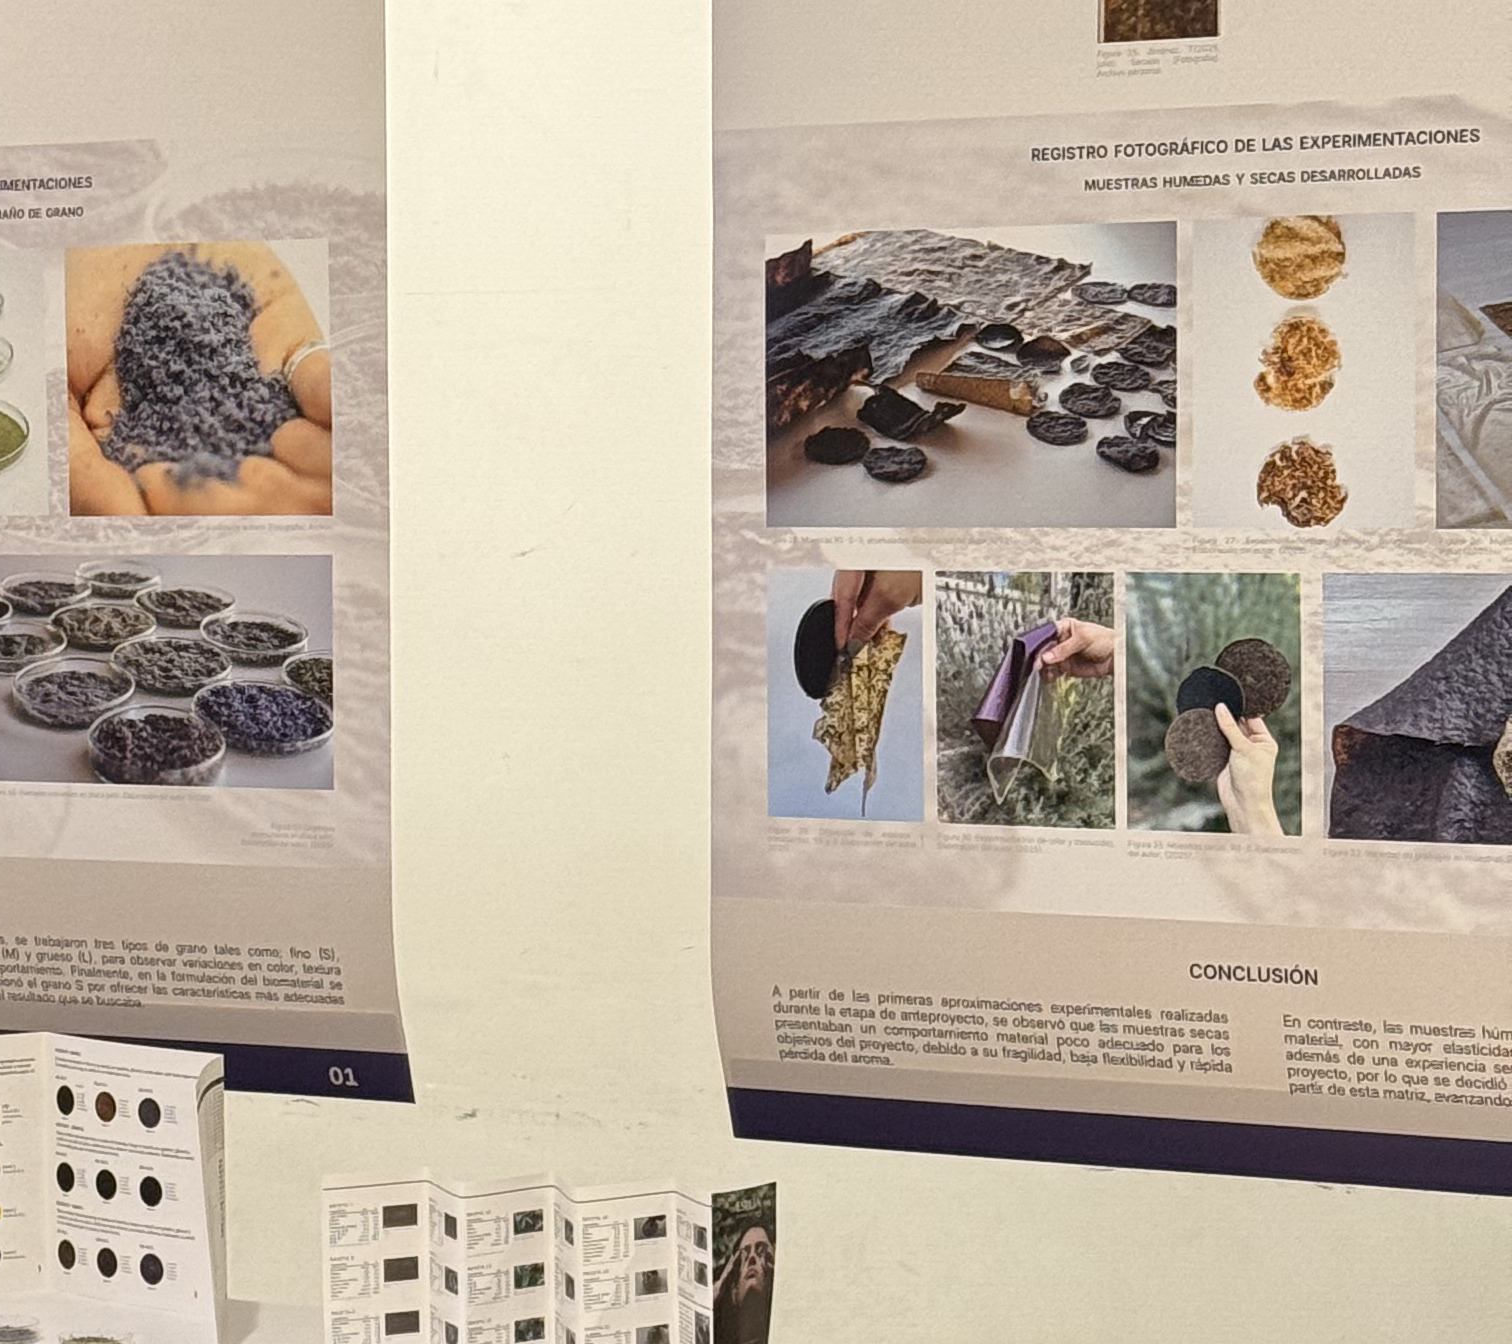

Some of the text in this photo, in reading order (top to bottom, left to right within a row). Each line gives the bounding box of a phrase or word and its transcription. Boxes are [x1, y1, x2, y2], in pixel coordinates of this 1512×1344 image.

[1031, 128, 1480, 161] REGISTRO FOTOGRÁFICO DE LAS EXPERIMENTACIONES
[1084, 176, 1157, 191] MUESTRAS
[1236, 172, 1245, 185] Y
[1250, 171, 1295, 185] SECAS
[1300, 166, 1421, 183] DESARROLLADAS
[28, 207, 41, 218] DE
[46, 206, 83, 218] GRANO
[1190, 963, 1317, 985] CONCLUSIÓN
[328, 1066, 359, 1087] 01
